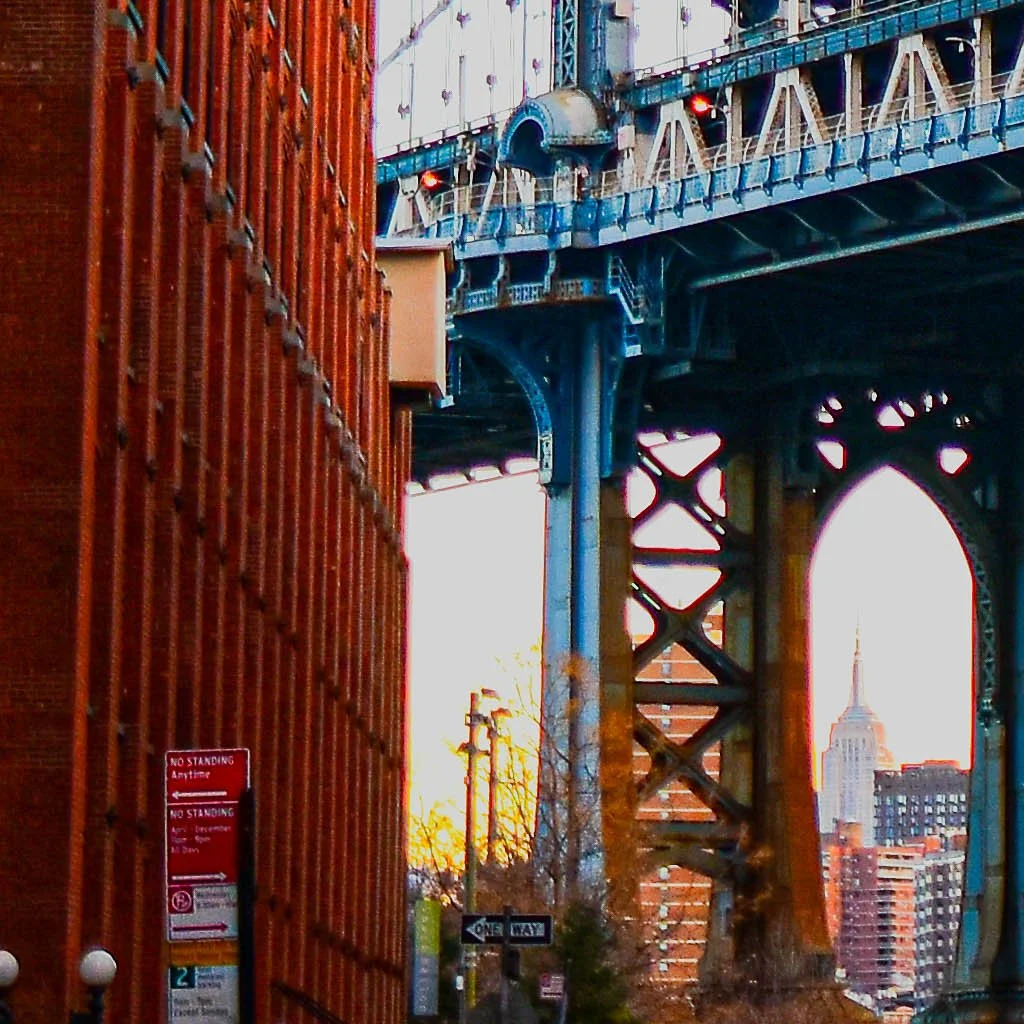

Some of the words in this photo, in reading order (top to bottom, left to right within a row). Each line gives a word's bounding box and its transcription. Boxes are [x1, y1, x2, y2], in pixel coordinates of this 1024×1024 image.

[170, 757, 184, 767] NO
[187, 755, 234, 767] STANDING
[171, 770, 210, 780] Anytime
[170, 809, 184, 819] NO
[187, 808, 234, 818] STANDING
[475, 922, 502, 937] ONE
[511, 922, 543, 937] WAY
[176, 967, 188, 986] 2
